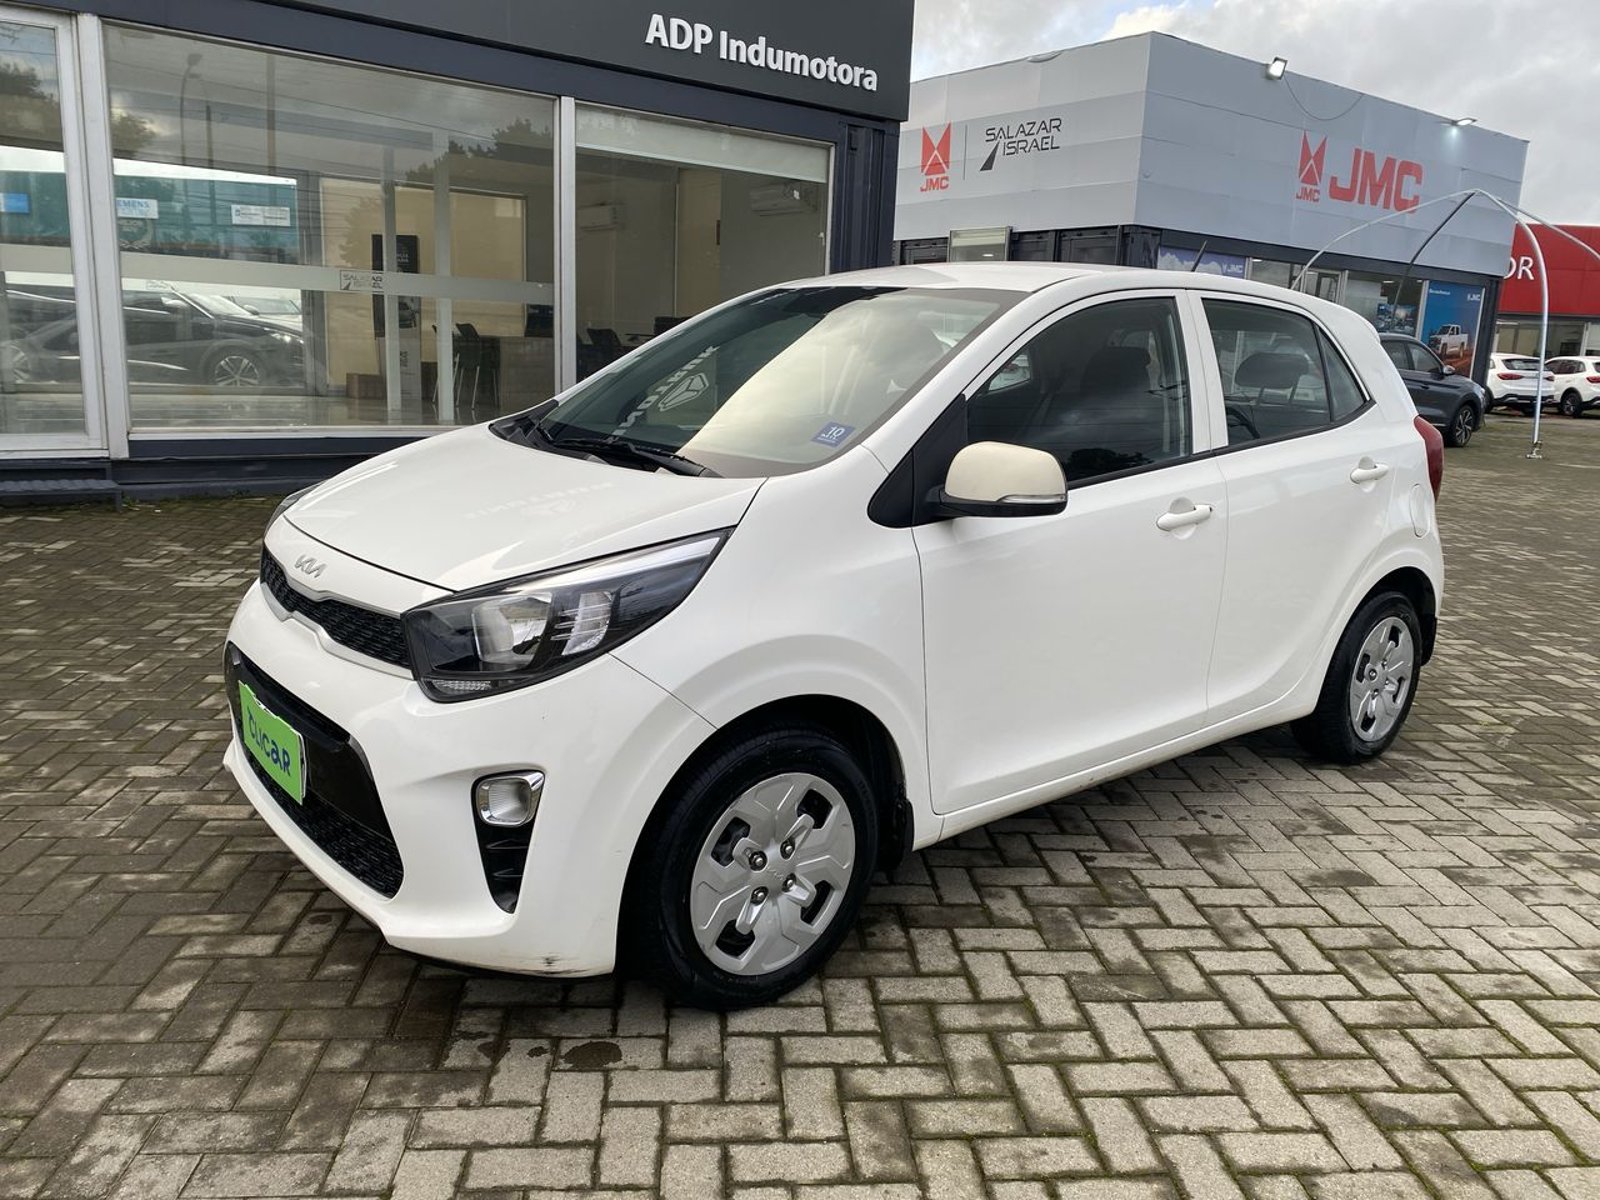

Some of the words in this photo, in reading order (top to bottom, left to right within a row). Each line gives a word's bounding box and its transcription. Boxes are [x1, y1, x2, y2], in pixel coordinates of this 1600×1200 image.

[645, 13, 713, 54] ADP
[719, 30, 878, 91] Indumotora
[985, 117, 1062, 143] SALAZAR
[1003, 135, 1060, 156] ISRAEL
[920, 176, 950, 192] JMC
[1328, 147, 1423, 214] JMC
[1296, 186, 1321, 203] JMC
[294, 554, 328, 578] KIA
